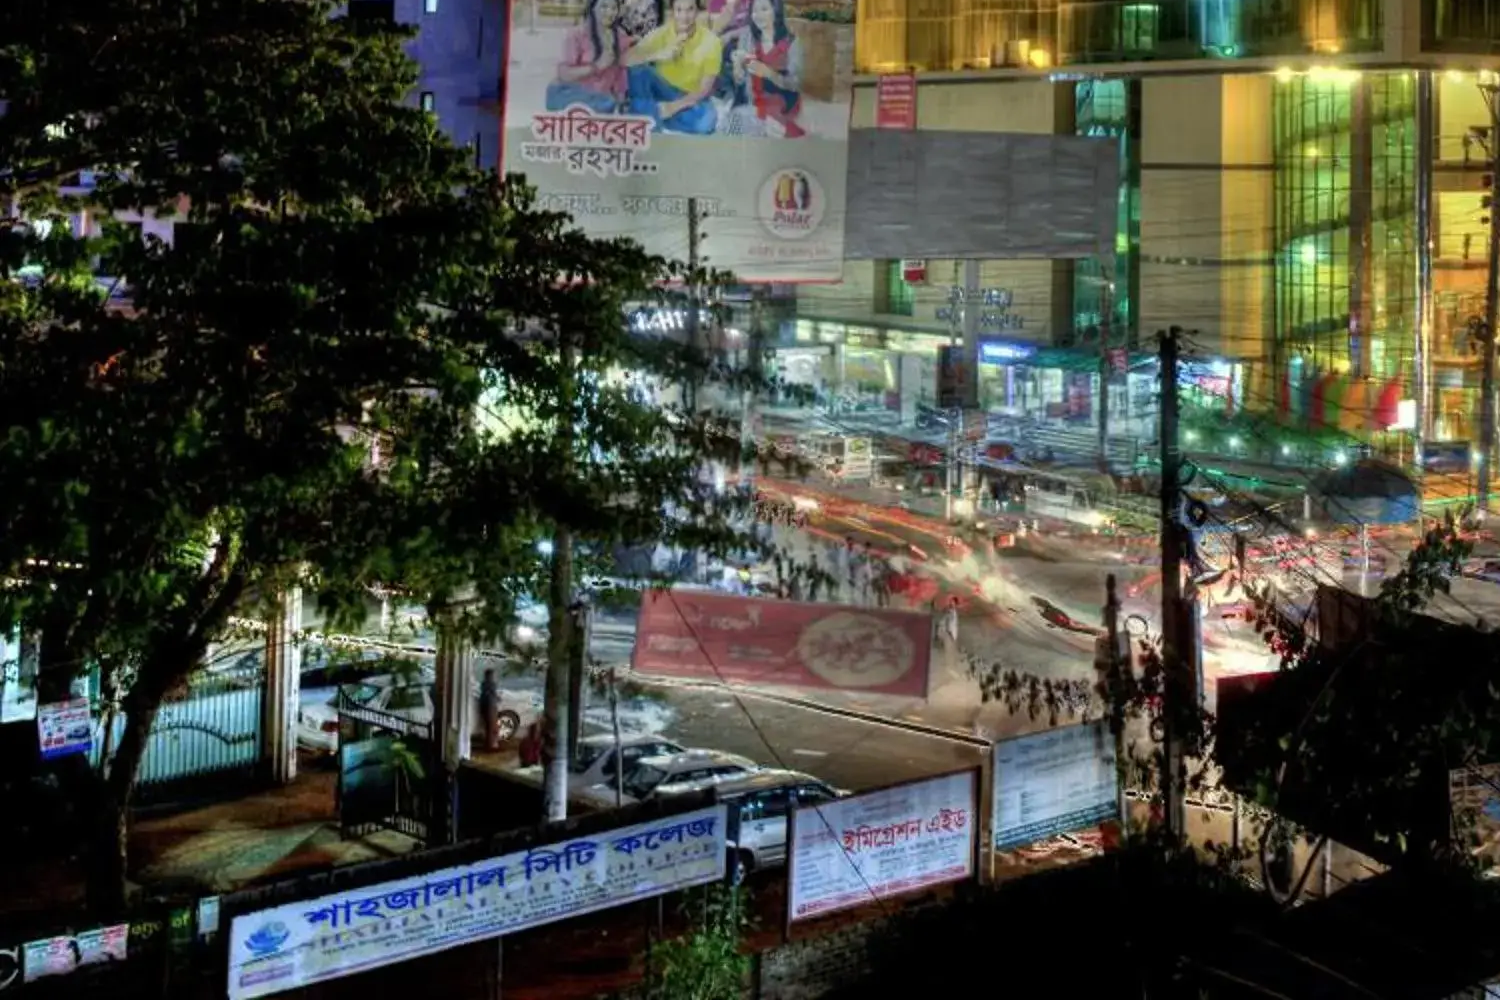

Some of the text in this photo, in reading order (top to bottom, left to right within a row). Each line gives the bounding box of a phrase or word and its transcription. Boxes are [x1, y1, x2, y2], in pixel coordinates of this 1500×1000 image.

[533, 108, 651, 146] সাকিবের
[841, 818, 923, 854] ইমিগ্রেশন
[926, 807, 967, 833] এইড
[303, 865, 505, 930] শাহজালাল
[523, 840, 599, 880] সিটি
[612, 816, 719, 856] কলেজ
